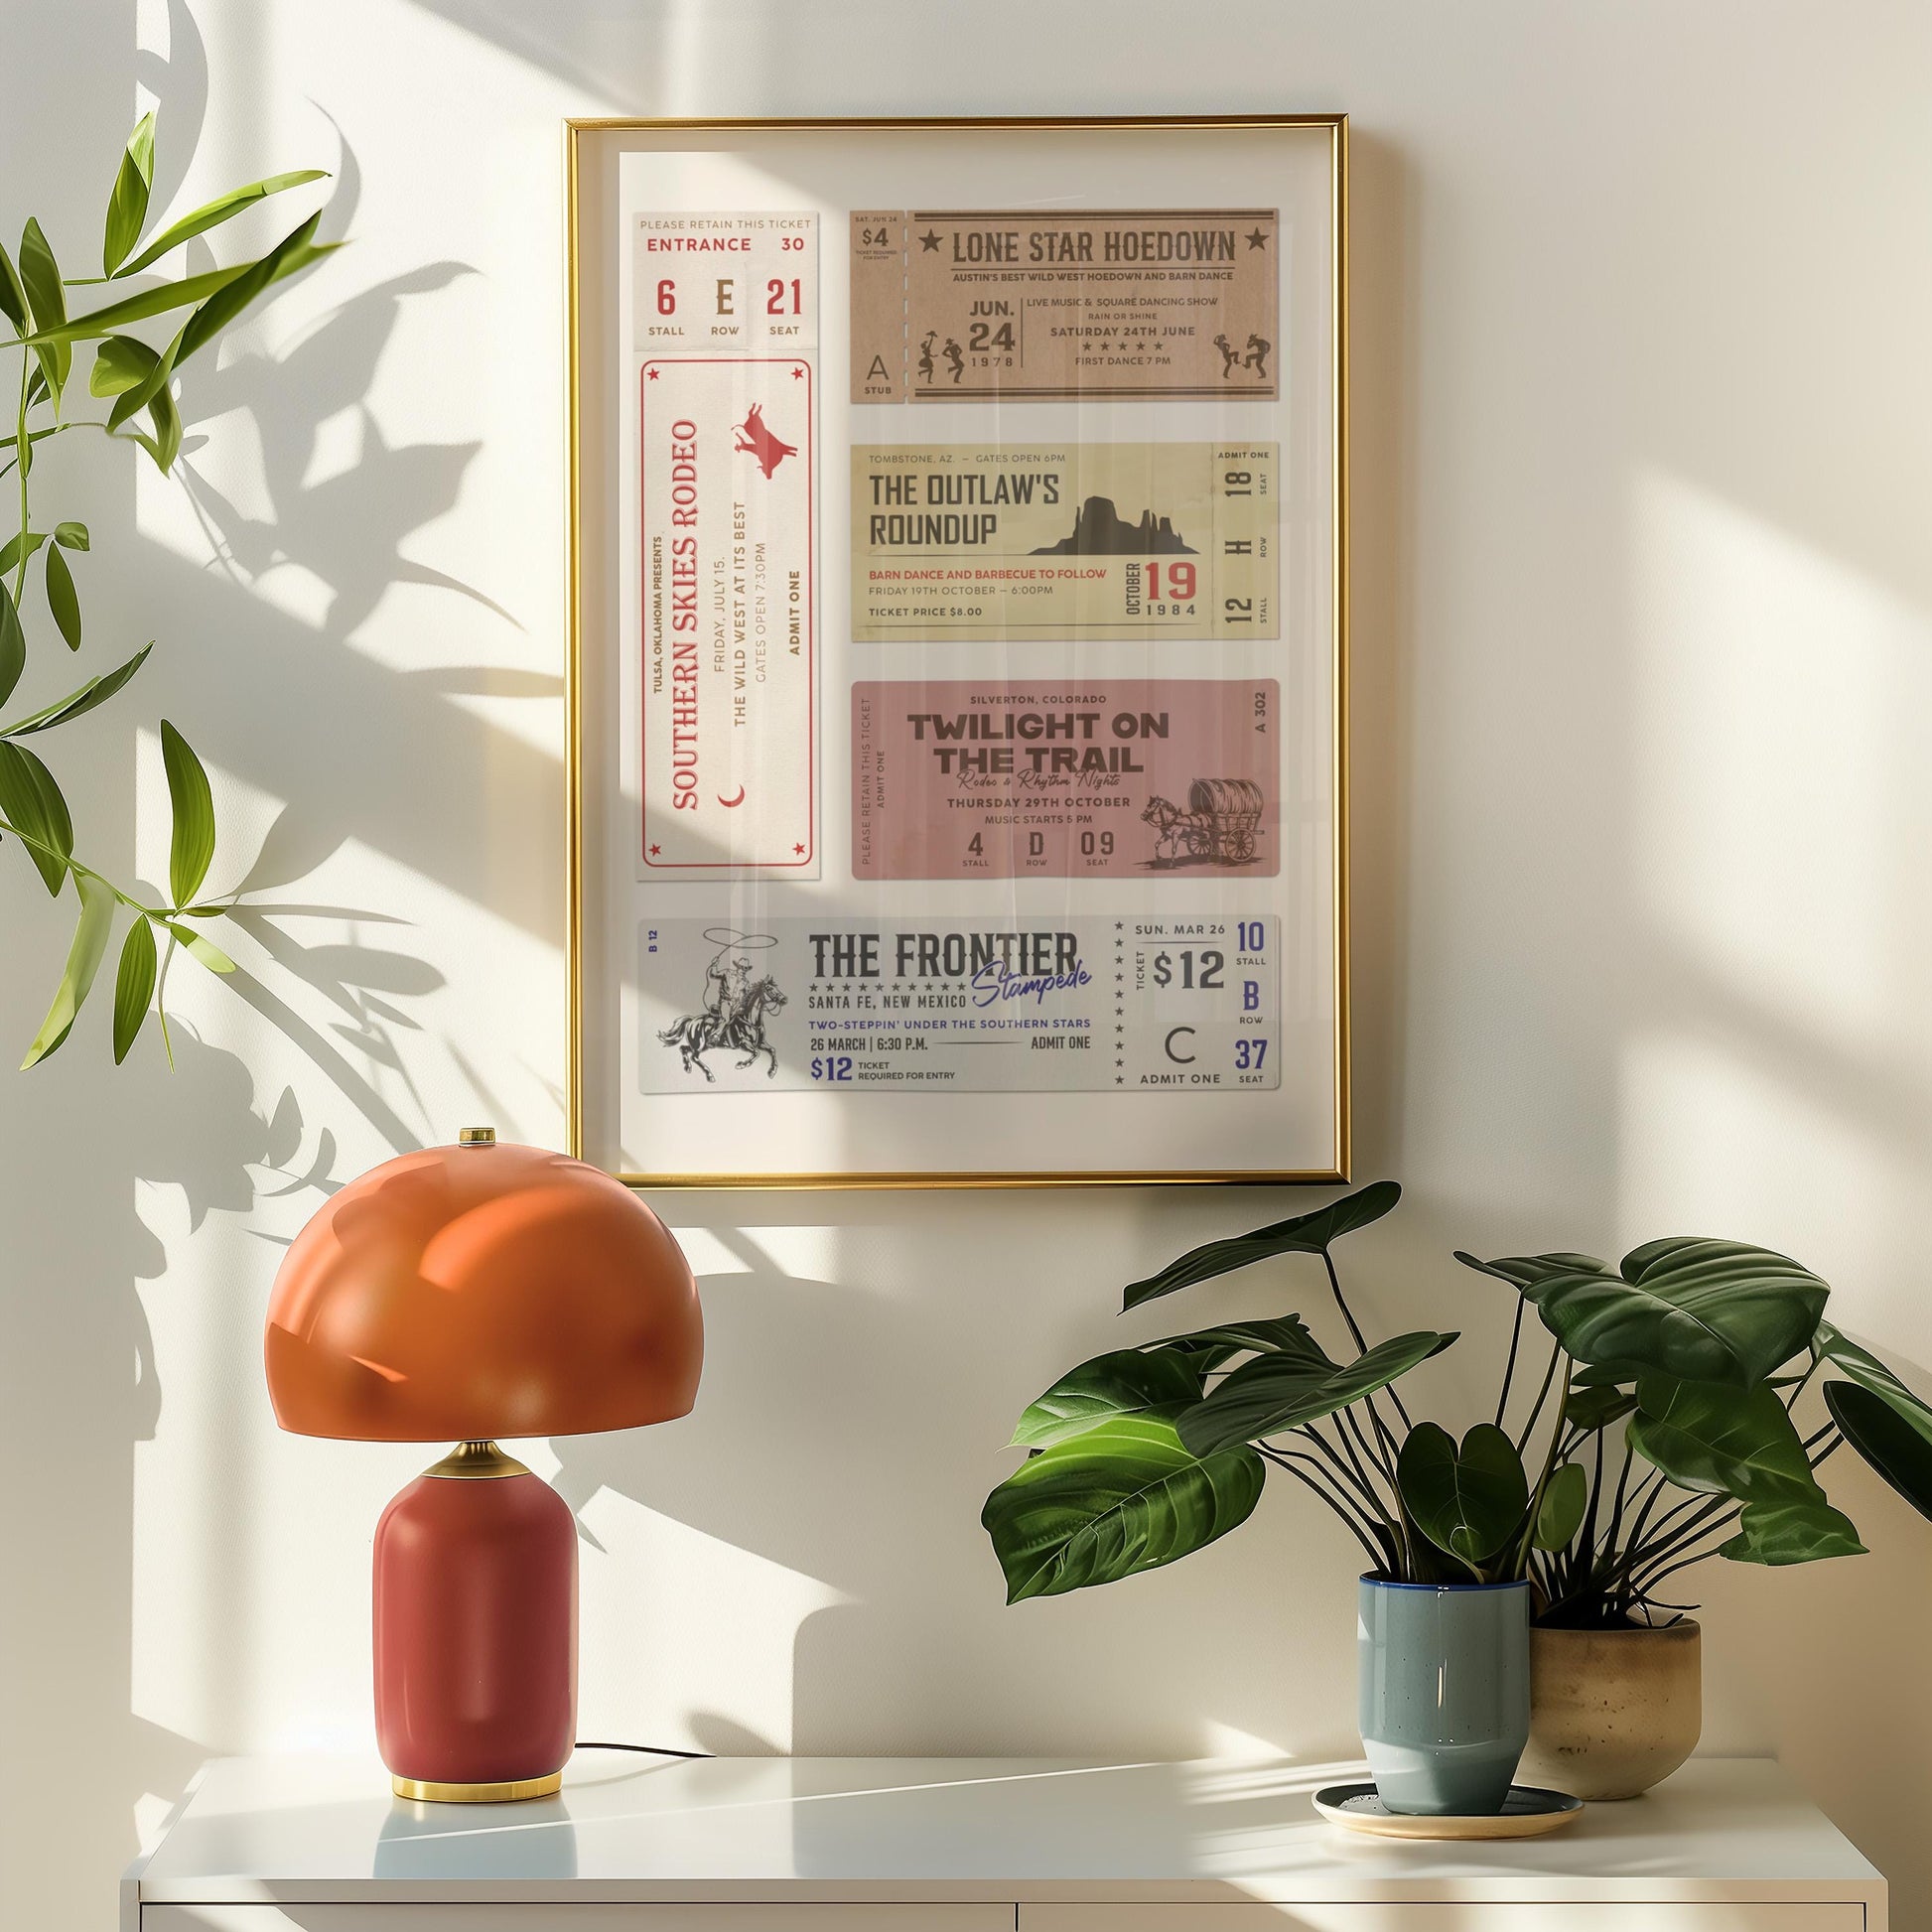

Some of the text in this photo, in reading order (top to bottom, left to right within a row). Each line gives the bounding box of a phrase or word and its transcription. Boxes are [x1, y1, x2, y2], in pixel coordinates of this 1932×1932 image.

[640, 219, 811, 229] PLEASE RETAIN THIS TICKET
[647, 237, 804, 251] ENTRANCE 30
[863, 227, 889, 246] $4
[953, 230, 1236, 262] LONE STAR HOEDOWN
[953, 273, 999, 282] AUSTIN'S
[1001, 273, 1026, 282] BEST
[1087, 272, 1142, 281] HOEDOWN
[1144, 272, 1166, 281] AND
[1169, 272, 1196, 281] BARN
[657, 279, 801, 315] 6 E 21
[969, 301, 1015, 317] JUN.
[1027, 298, 1048, 307] LIVE
[1050, 298, 1081, 307] MUSIC
[1084, 298, 1092, 307] &
[1096, 297, 1137, 308] SQUARE
[1187, 297, 1218, 306] SHOW
[648, 326, 799, 336] STALL ROW SEAT
[969, 323, 1016, 351] 24
[1050, 327, 1195, 337] SATURDAY 24TH JUNE
[867, 354, 890, 380] A
[972, 357, 1013, 367] 1978
[1075, 356, 1104, 365] FIRST
[1107, 356, 1144, 365] DANCE
[1012, 454, 1040, 463] OPEN
[1044, 454, 1065, 463] 6PM
[869, 474, 1058, 505] THE OUTLAW'S
[1224, 472, 1252, 497] 18
[871, 514, 997, 545] ROUNDUP
[1225, 540, 1252, 555] H
[869, 569, 1107, 580] BARN DANCE AND BARBECUE TO FOLLOW
[1145, 562, 1196, 601] 19
[714, 580, 726, 613] JULY
[869, 587, 908, 596] FRIDAY
[941, 586, 996, 596] OCTOBER
[1012, 586, 1053, 595] 6:00PM
[1126, 563, 1141, 615] OCTOBER
[653, 536, 663, 694] TULSA, OKLAHOMA PRESENTS
[672, 421, 699, 810] SOUTHERN SKIES RODEO
[734, 501, 746, 727] THE WILD WEST AT ITS BEST
[755, 542, 766, 683] GATES OPEN 7:30PM
[789, 571, 800, 655] ADMIT ONE
[869, 607, 982, 617] TICKET PRICE $8.00
[1147, 605, 1195, 616] 1984
[1225, 599, 1252, 623] 12
[970, 695, 1106, 705] SILVERTON, COLORADO
[1255, 692, 1266, 733] A 302
[907, 712, 1169, 741] TWILIGHT ON
[933, 747, 1145, 774] THE TRAIL
[1017, 767, 1071, 791] Rhythm
[1074, 767, 1121, 791] Nights
[947, 797, 1130, 808] THURSDAY 29TH OCTOBER
[985, 815, 1020, 825] MUSIC
[1023, 815, 1063, 824] STARTS
[1066, 815, 1073, 824] 5
[968, 831, 1114, 856] 4 D 09
[648, 930, 657, 940] 12
[1136, 924, 1225, 935] SUN. MAR 26
[1238, 921, 1264, 951] 10
[809, 932, 1079, 978] THE FRONTIER
[1153, 950, 1224, 989] $12
[971, 958, 1092, 1008] Stampede
[809, 995, 966, 1010] SANTA FE, NEW MEXICO
[1243, 981, 1259, 1011] B
[904, 1020, 947, 1030] UNDER
[951, 1020, 976, 1029] THE
[980, 1020, 1048, 1029] SOUTHERN
[1052, 1019, 1090, 1028] STARS
[811, 1037, 928, 1051] 26 MARCH 6:30 P.M.
[1031, 1035, 1090, 1049] ADMIT ONE
[1165, 1027, 1196, 1064] C
[1235, 1039, 1268, 1069] 37
[811, 1056, 852, 1081] $12
[1140, 1074, 1220, 1084] ADMIT ONE
